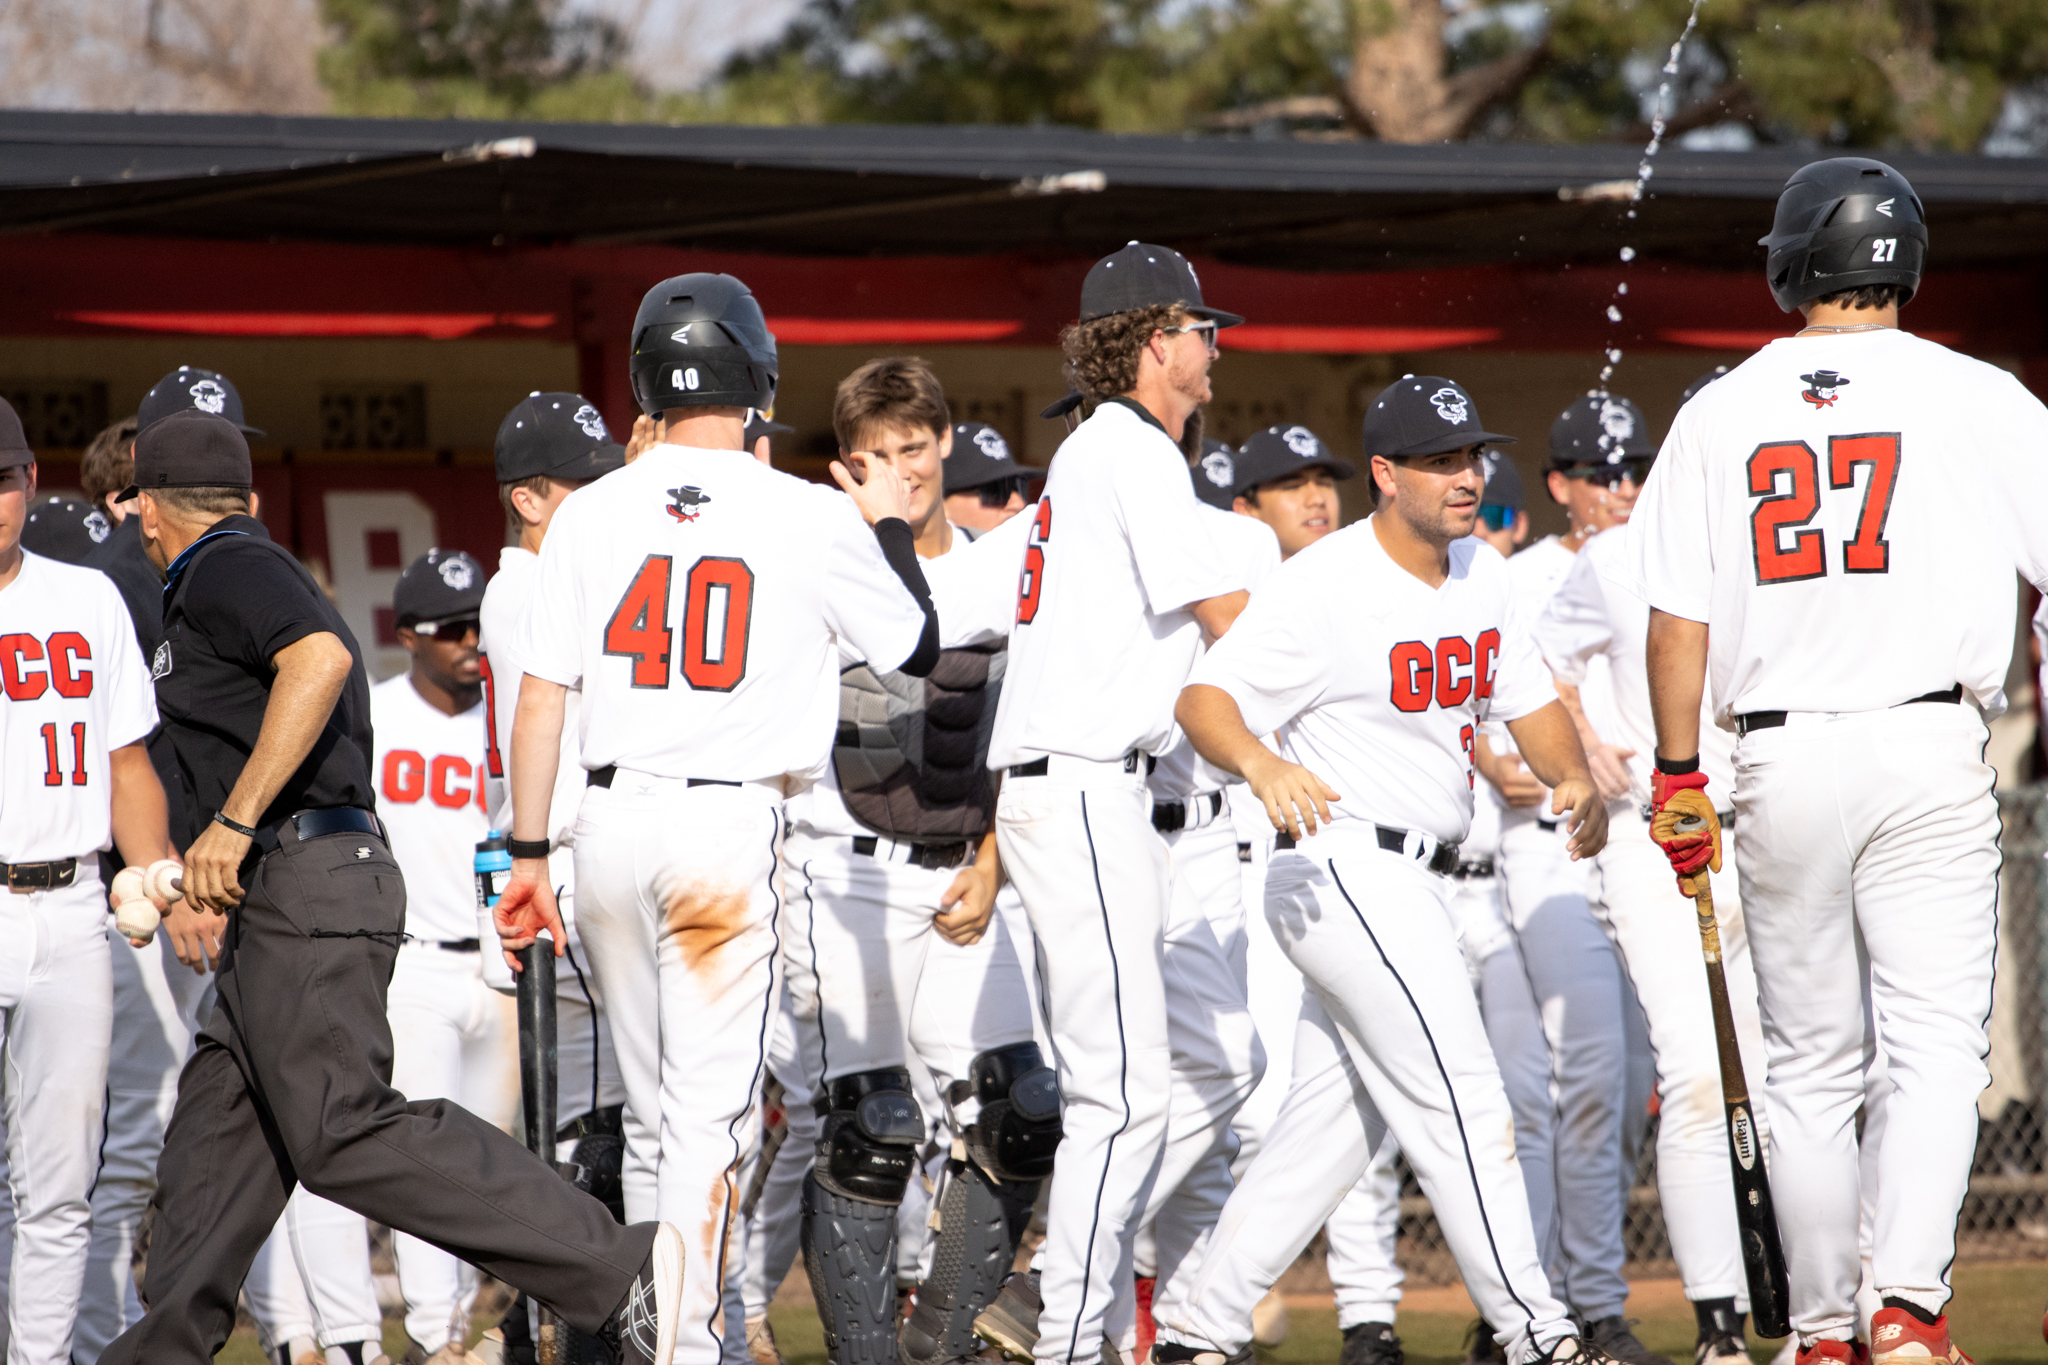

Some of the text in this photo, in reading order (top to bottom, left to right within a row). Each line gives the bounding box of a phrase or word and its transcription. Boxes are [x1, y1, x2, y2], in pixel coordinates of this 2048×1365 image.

[1872, 238, 1897, 262] 27
[671, 367, 699, 391] 40
[1746, 432, 1902, 586] 27
[602, 554, 755, 693] 40
[0, 631, 93, 702] CC
[1388, 627, 1501, 713] GCC
[40, 721, 88, 787] 11
[381, 749, 487, 814] GC
[1736, 1118, 1751, 1159] Baum
